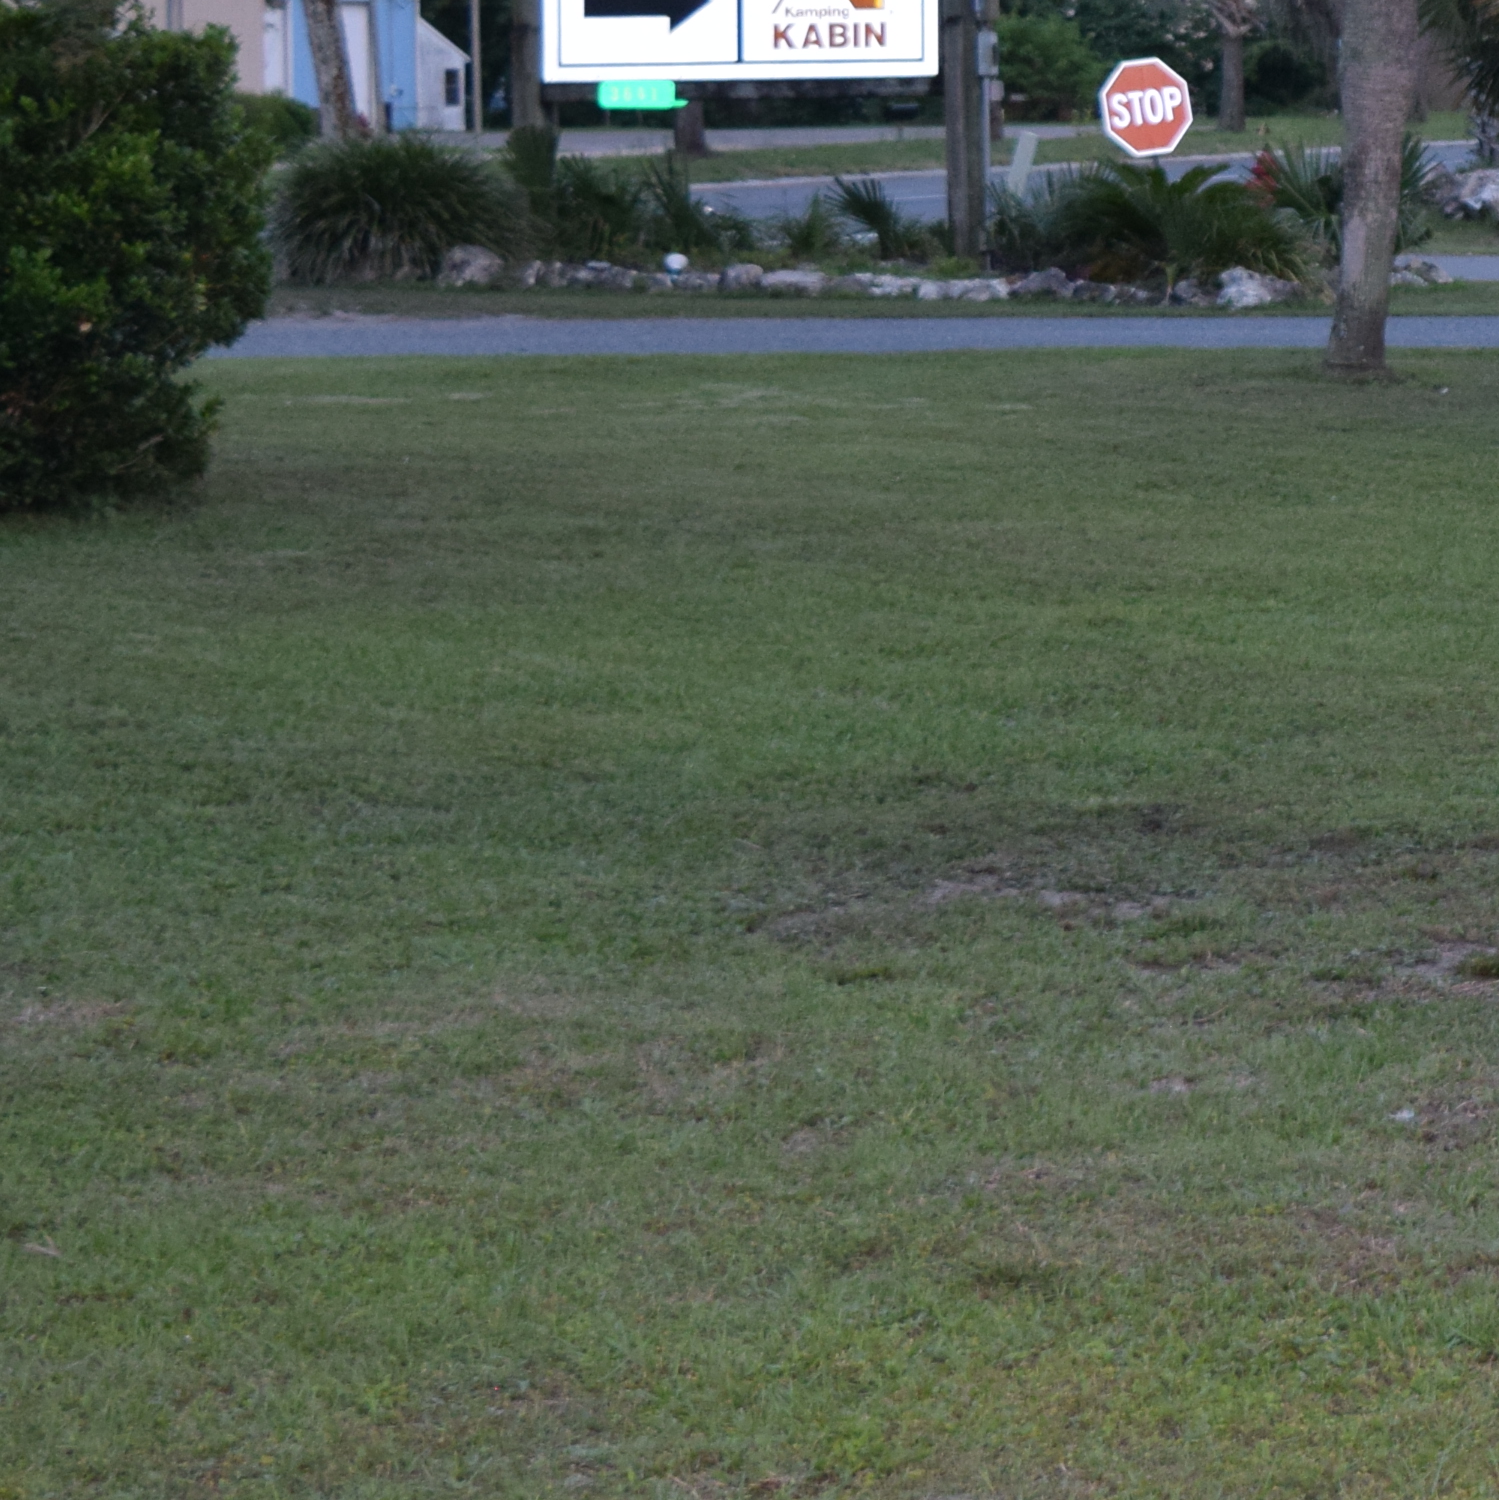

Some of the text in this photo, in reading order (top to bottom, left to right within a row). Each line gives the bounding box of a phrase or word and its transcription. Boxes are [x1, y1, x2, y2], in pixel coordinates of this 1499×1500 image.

[785, 6, 850, 19] Kamping
[773, 21, 887, 49] KABIN
[1110, 86, 1182, 129] STOP
